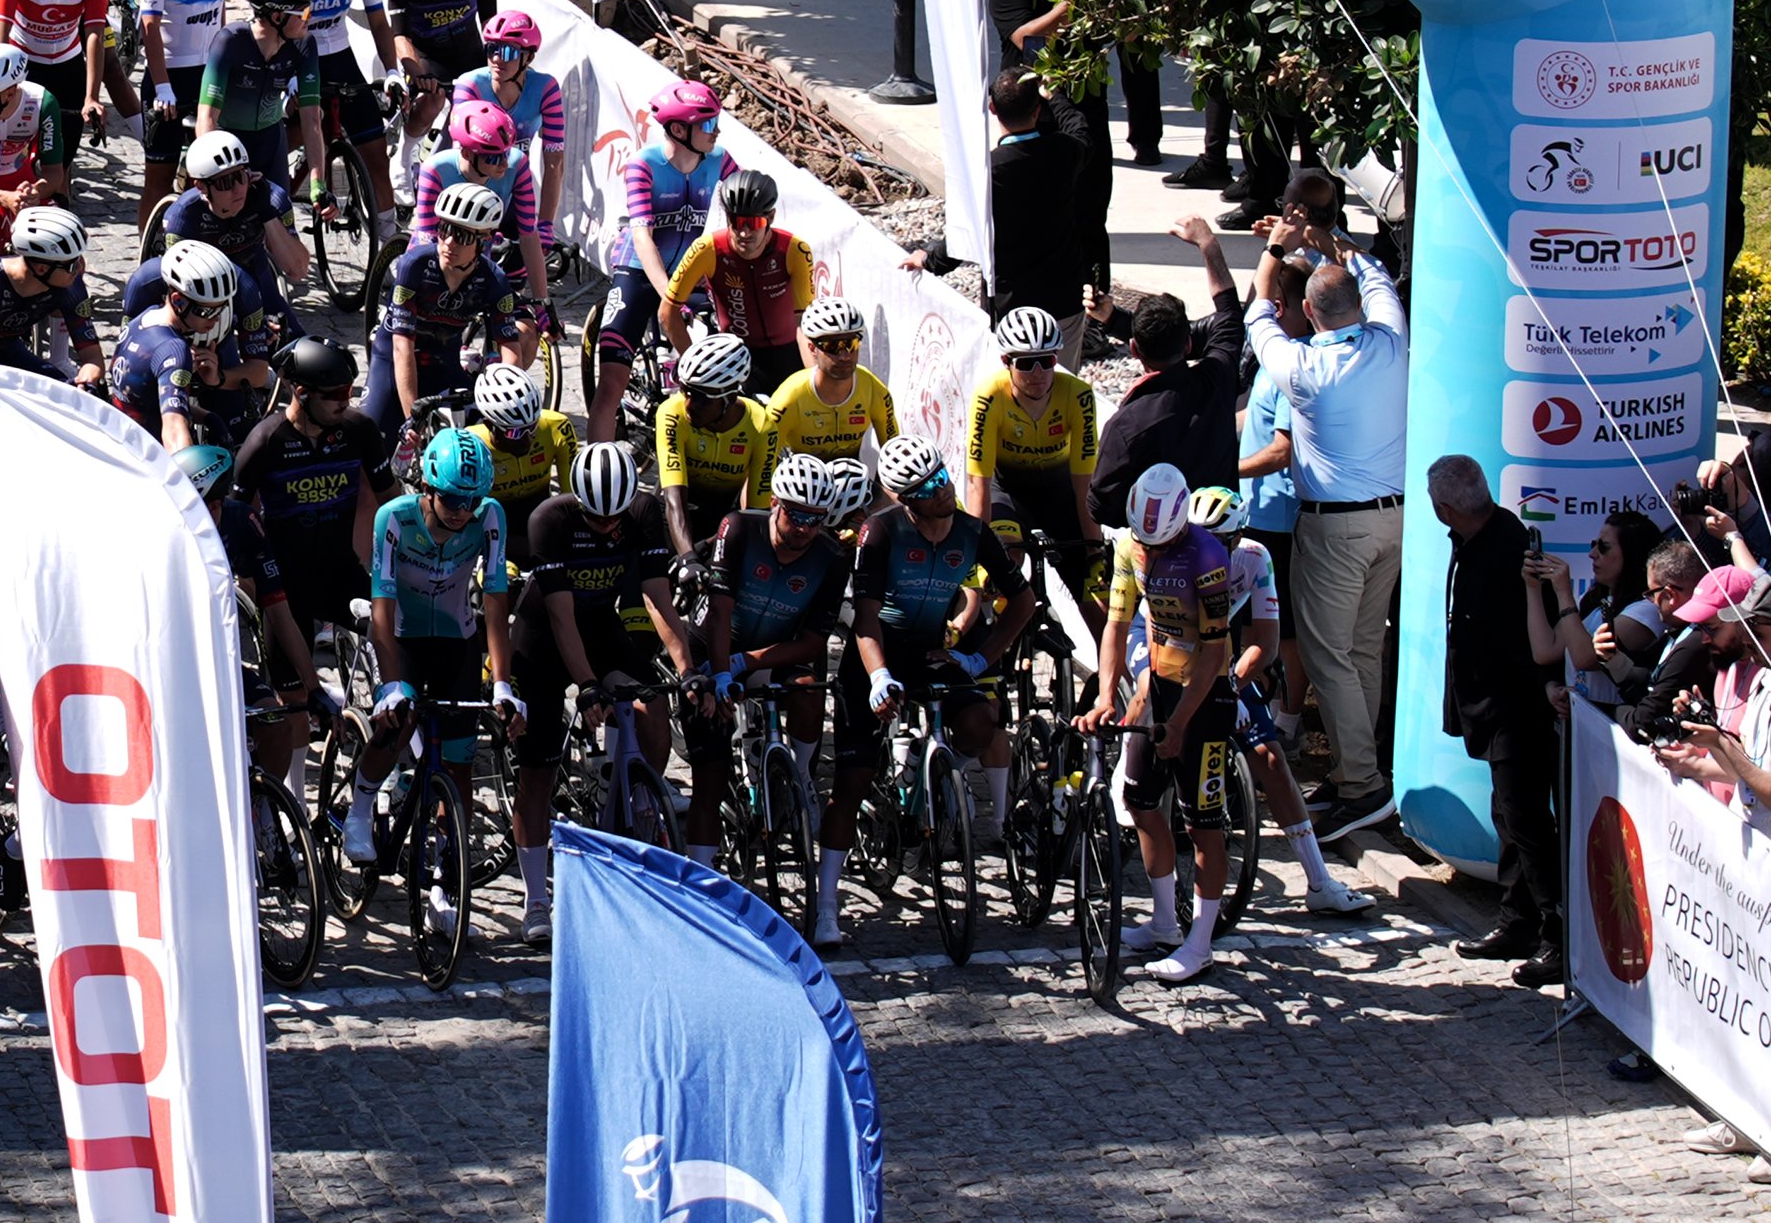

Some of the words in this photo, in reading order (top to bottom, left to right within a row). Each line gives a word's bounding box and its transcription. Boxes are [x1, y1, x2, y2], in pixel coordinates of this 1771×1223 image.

[1608, 66, 1633, 78] T.C.
[1636, 59, 1686, 78] GENÇLİK
[1688, 58, 1701, 69] VE
[1608, 81, 1641, 94] SPOR
[1644, 73, 1701, 92] BAKANLIĞI
[1654, 143, 1702, 176] UCI
[672, 238, 706, 283] Cofidis
[730, 287, 750, 339] Cofidis
[1523, 323, 1572, 344] Türk
[1579, 325, 1666, 344] Telekom
[1526, 343, 1563, 356] Değerli
[1565, 345, 1616, 356] Hissettirir
[1595, 392, 1685, 420] TURKISH
[1593, 416, 1685, 443] AIRLINES
[286, 472, 349, 494] KONYA
[297, 485, 339, 504] BBSK
[566, 565, 625, 581] KONYA
[1195, 570, 1227, 588] isorex
[1199, 743, 1222, 811] isorex
[1668, 820, 1714, 876] Under
[1715, 862, 1734, 899] the
[1664, 942, 1751, 1037] REPUBLIC
